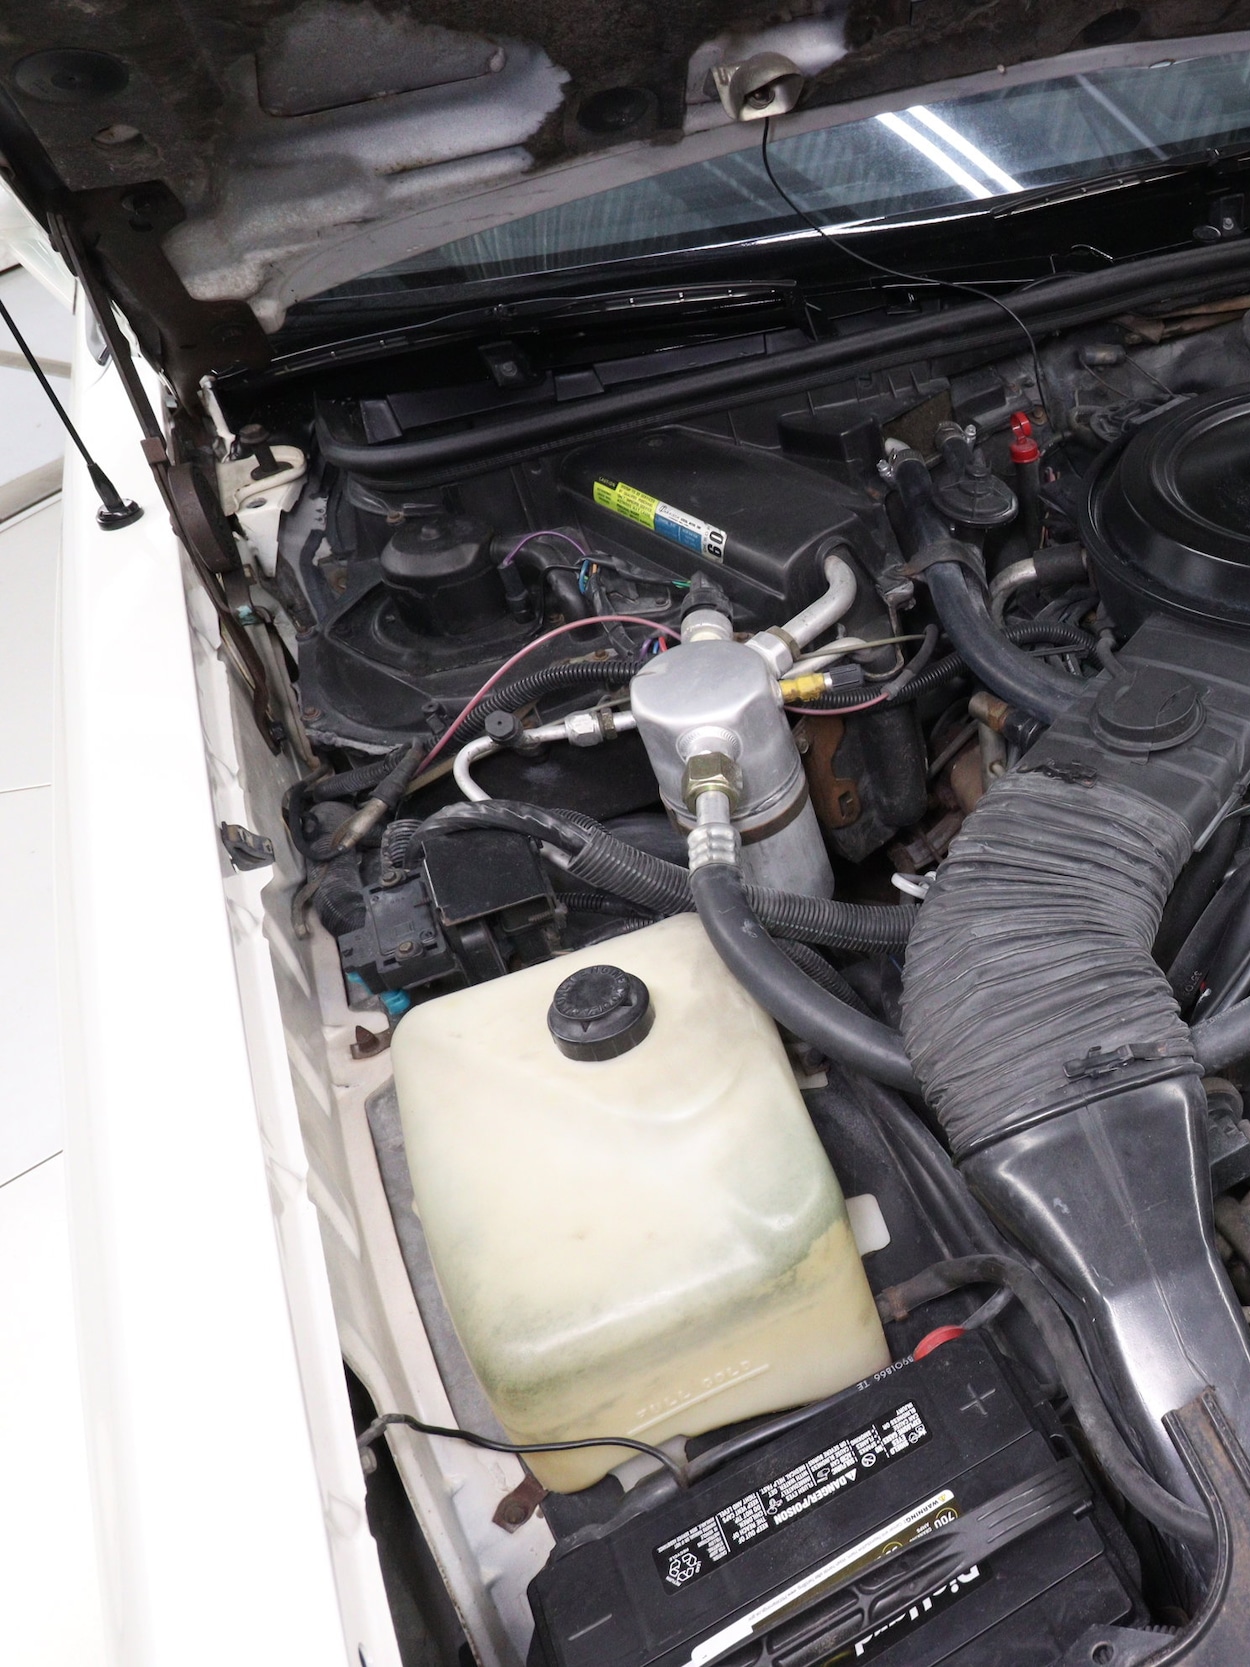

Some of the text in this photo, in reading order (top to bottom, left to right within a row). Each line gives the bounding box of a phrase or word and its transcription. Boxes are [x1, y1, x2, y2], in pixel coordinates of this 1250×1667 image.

[707, 531, 723, 557] 60
[855, 1379, 870, 1391] TE
[881, 1421, 891, 1430] OR
[892, 1411, 919, 1431] CAN CAUSE
[881, 1417, 922, 1444] EXPLOSIVE GASES
[838, 1440, 847, 1448] OR
[873, 1444, 883, 1453] NO
[888, 1438, 909, 1455] SHIELD
[890, 1433, 906, 1447] EYES
[809, 1445, 850, 1472] CAUSE BLINDNESS
[829, 1451, 852, 1468] ACID CAN
[830, 1456, 855, 1475] SULFURIC
[758, 1463, 806, 1495] MEDICAL HELP FAST.
[794, 1469, 809, 1481] WITH
[766, 1487, 778, 1497] GET
[778, 1475, 811, 1497] IMMEDIATELY
[784, 1480, 814, 1501] FLUSH EYES
[730, 1500, 743, 1510] AND
[740, 1492, 756, 1505] TIGHT
[772, 1474, 848, 1525] DANGER/POISON
[721, 1498, 759, 1523] KEEP VENT CAPS
[741, 1508, 754, 1519] NOT
[751, 1504, 761, 1513] DO
[730, 1515, 766, 1540] THE REACH OF
[735, 1521, 769, 1544] KEEP OUT OF
[915, 1521, 930, 1533] AMPS
[667, 1546, 689, 1562] RECYCLE
